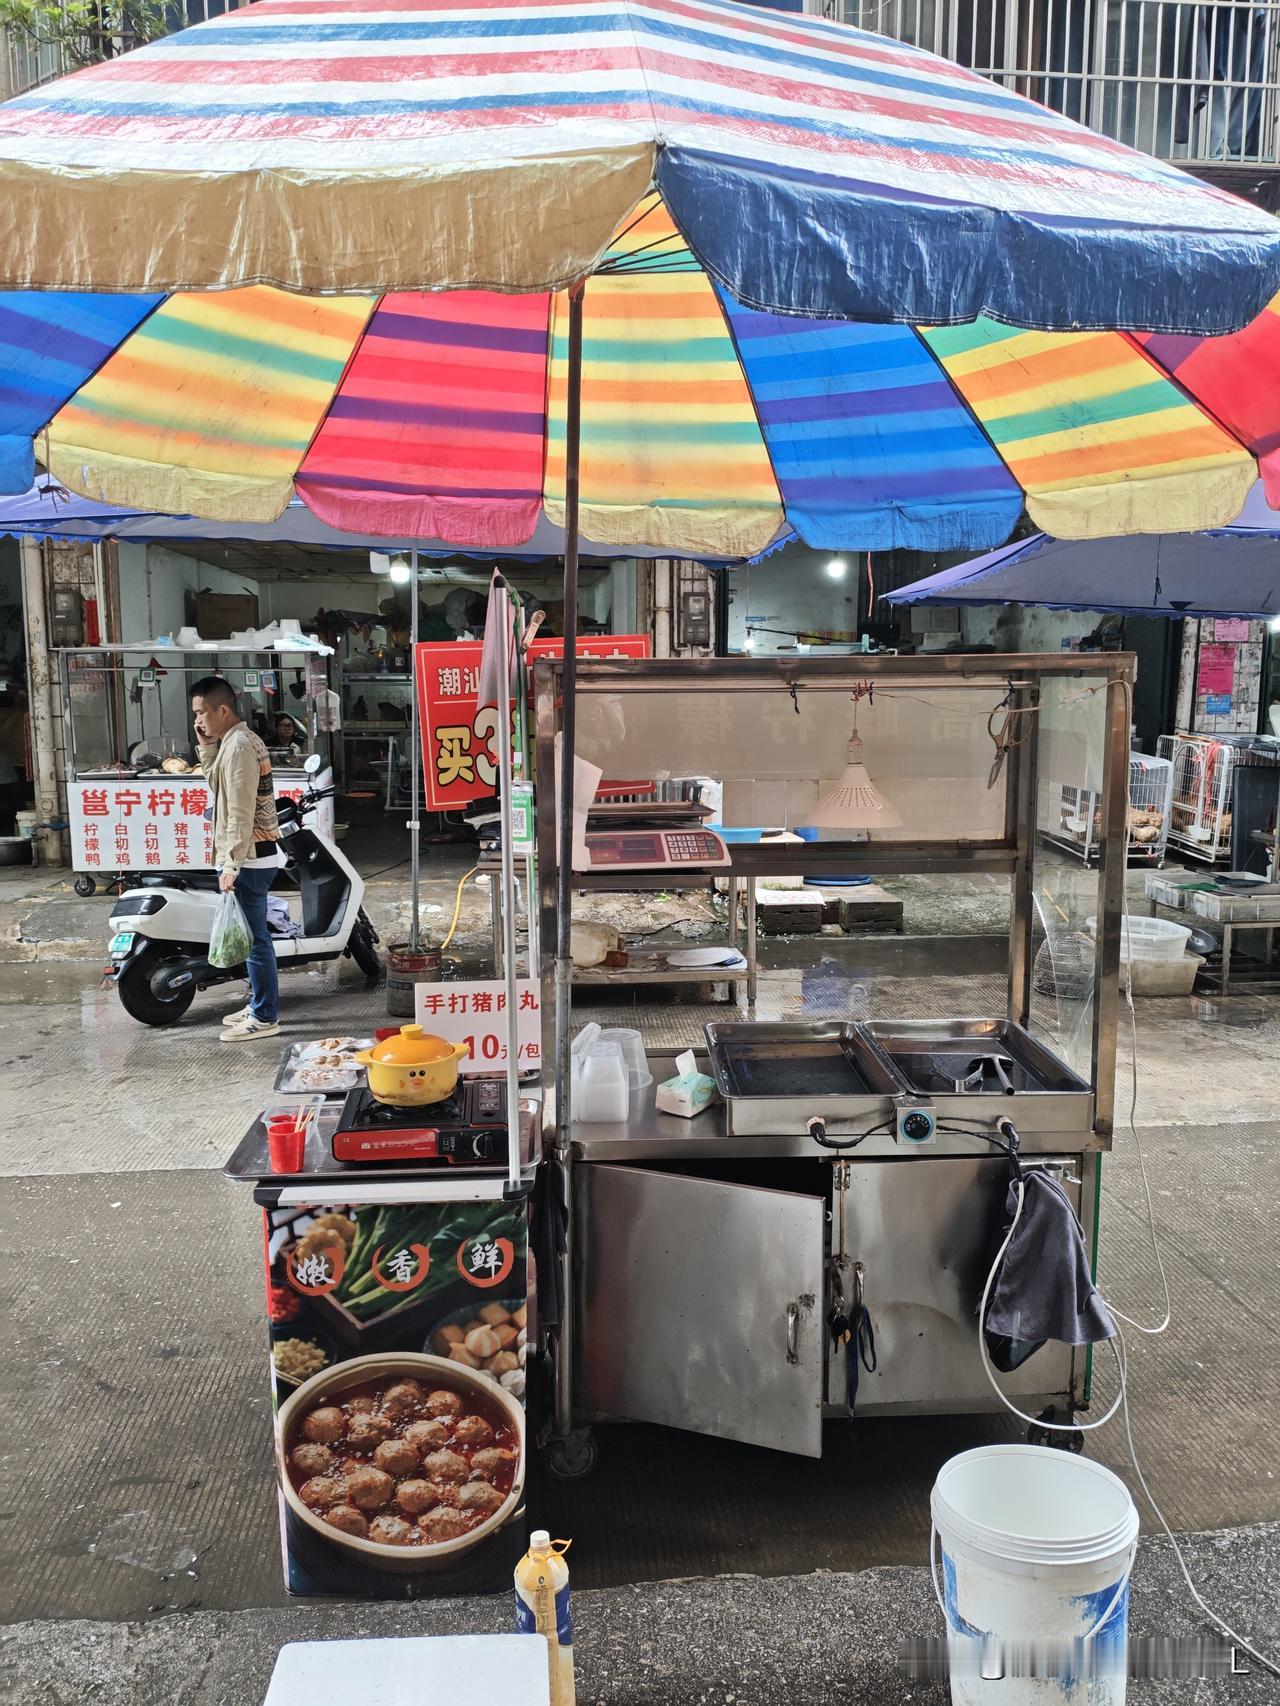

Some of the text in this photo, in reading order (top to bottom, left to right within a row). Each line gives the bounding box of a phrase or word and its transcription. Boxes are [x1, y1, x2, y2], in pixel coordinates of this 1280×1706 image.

[83, 822, 101, 866] 柠檬鸭
[114, 822, 131, 866] 白切鸡
[144, 822, 161, 865] 白切鹅
[174, 822, 190, 865] 猪耳朵
[296, 1243, 503, 1287] 嫩 香 鲜
